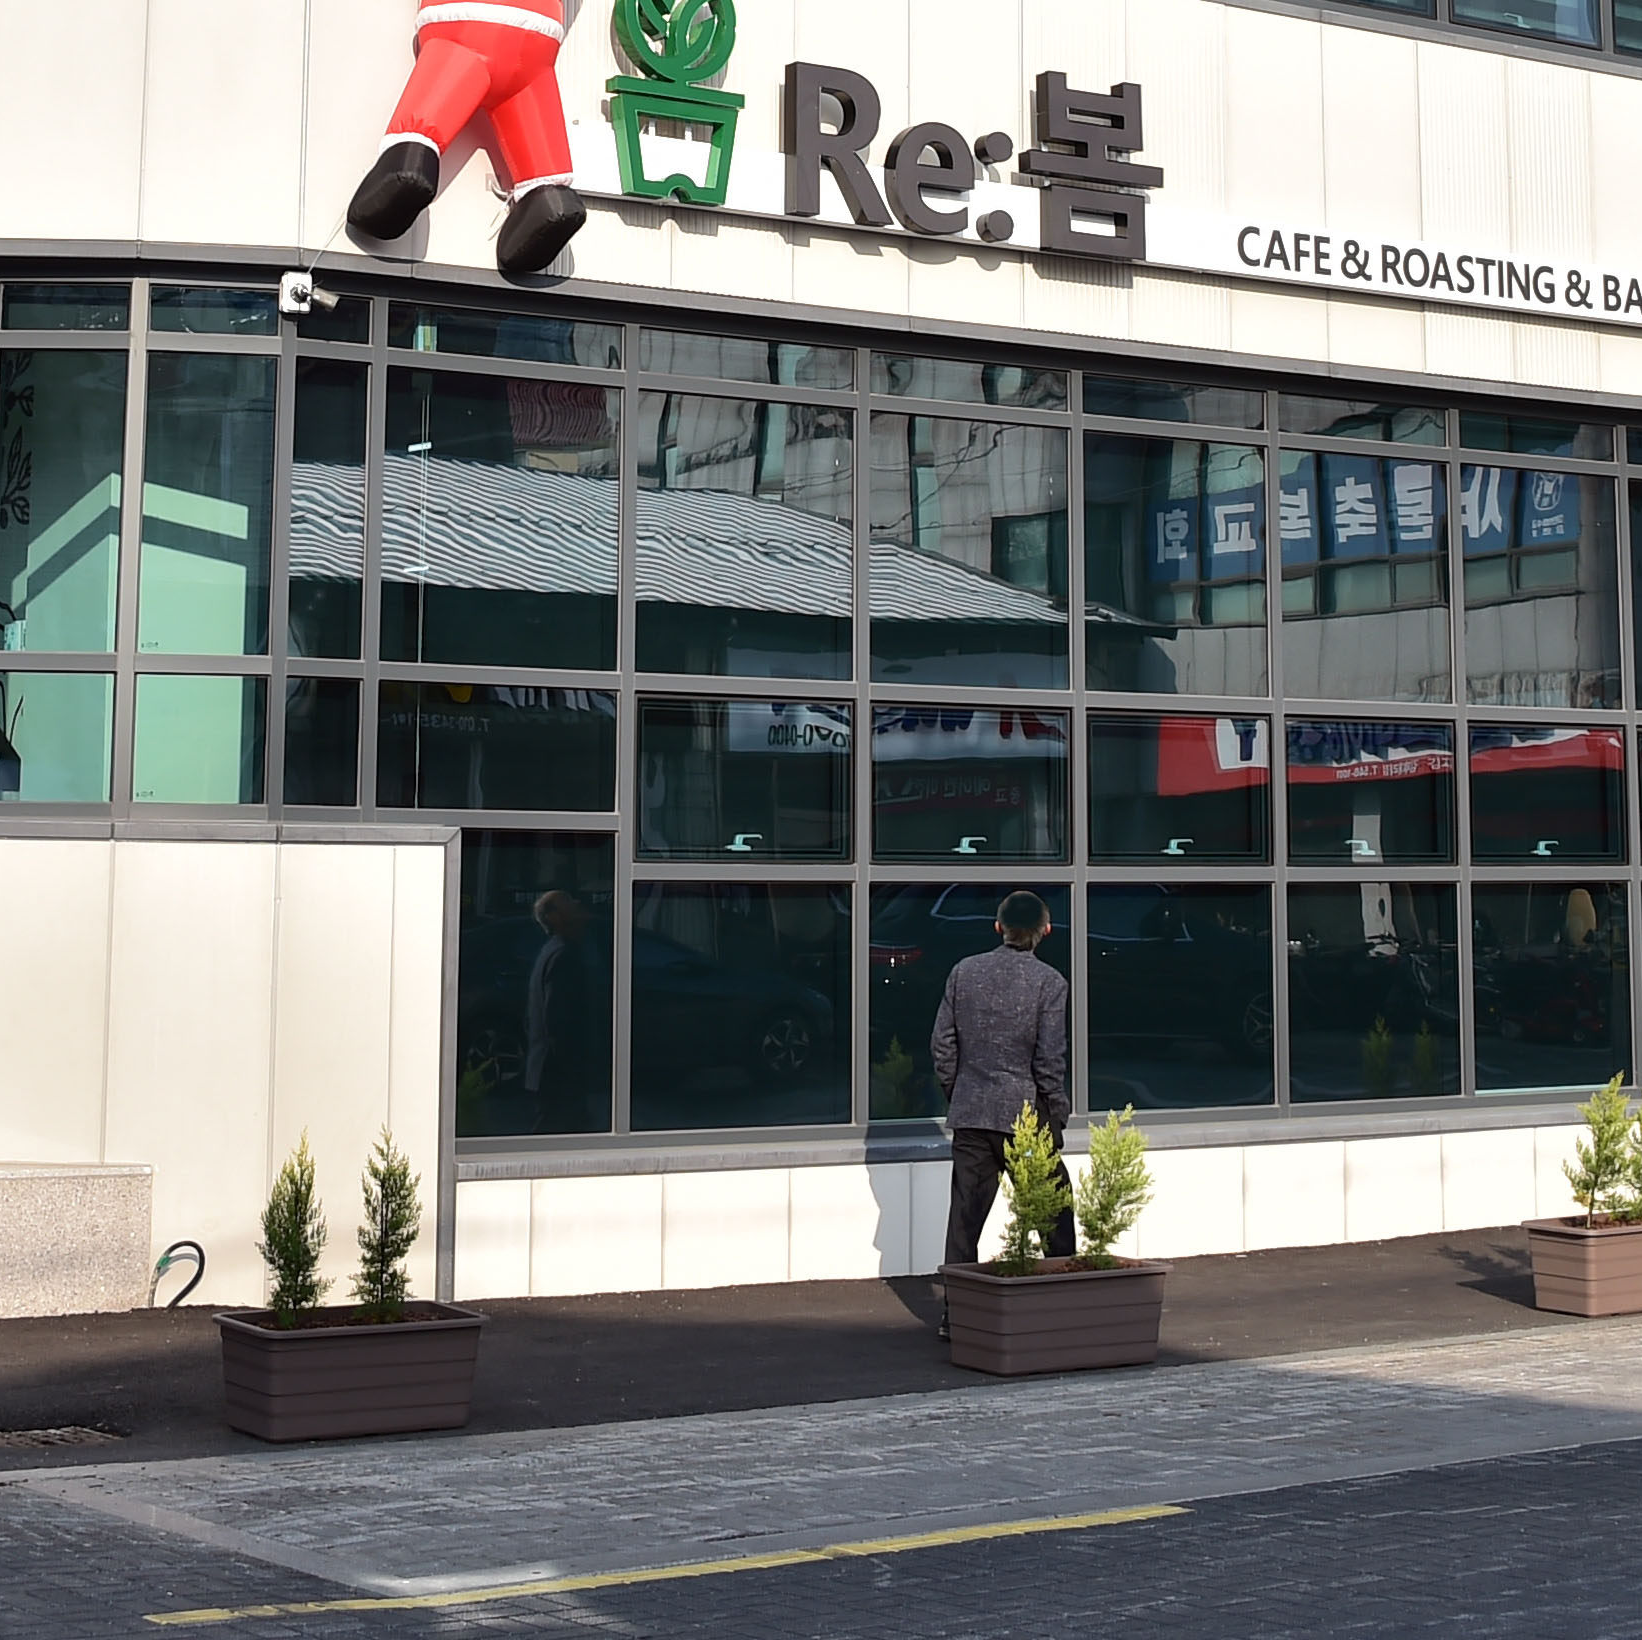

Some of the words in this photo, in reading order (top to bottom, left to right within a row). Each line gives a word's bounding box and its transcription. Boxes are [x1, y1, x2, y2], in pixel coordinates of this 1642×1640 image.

[783, 60, 1165, 261] Re:봄
[1236, 225, 1332, 276] CAFE
[1340, 239, 1372, 282] &
[1380, 243, 1557, 304] ROASTING
[1564, 269, 1594, 309] &
